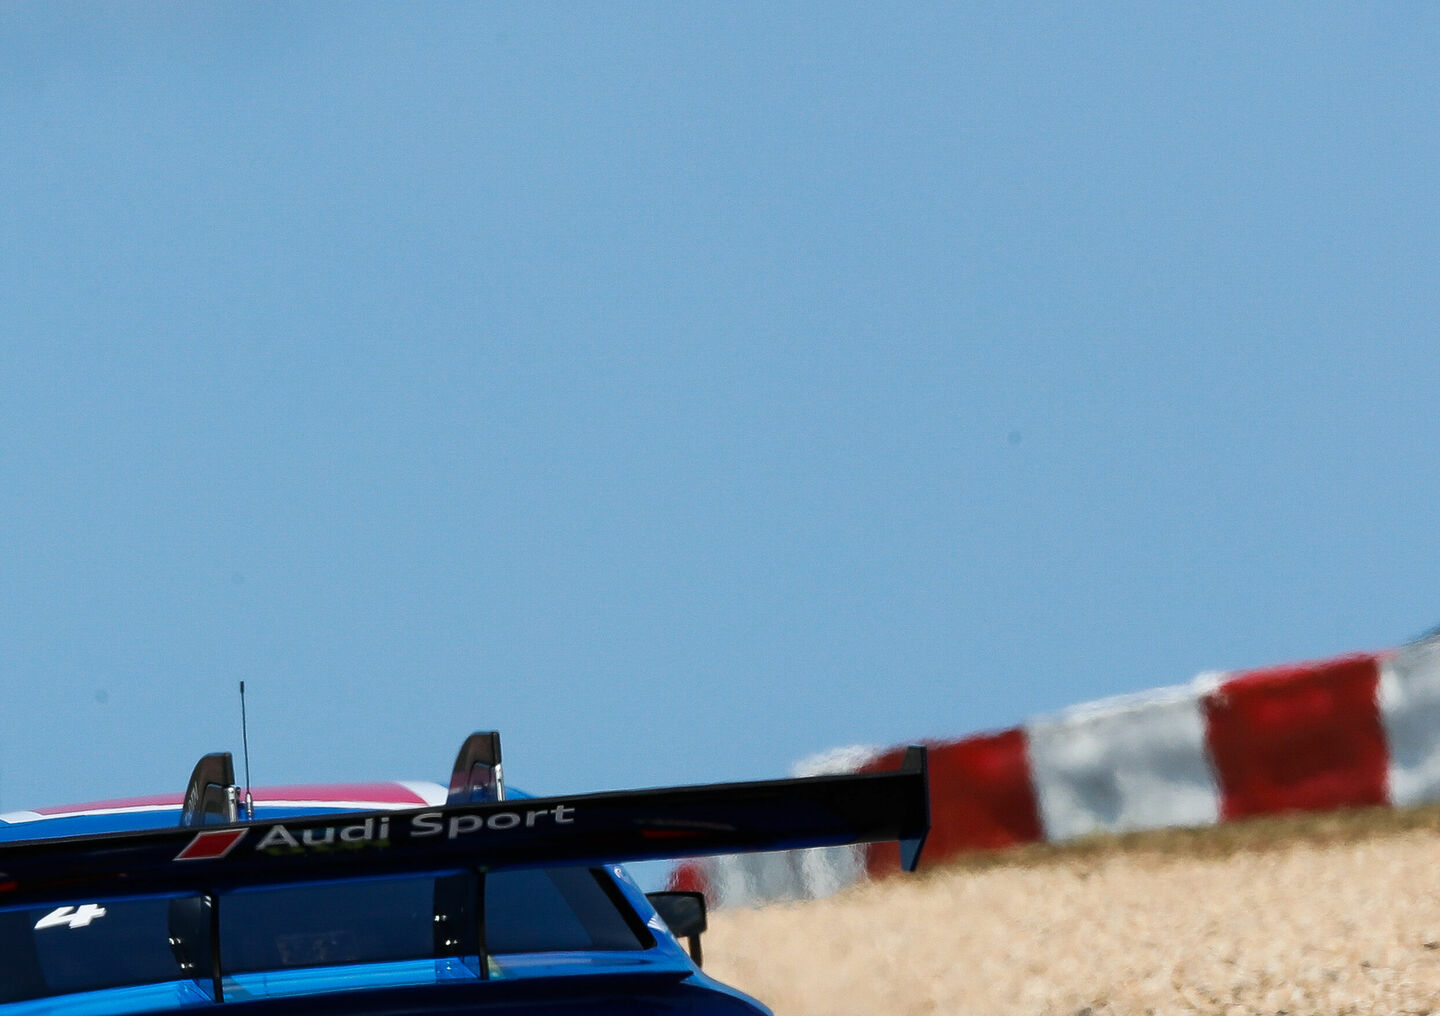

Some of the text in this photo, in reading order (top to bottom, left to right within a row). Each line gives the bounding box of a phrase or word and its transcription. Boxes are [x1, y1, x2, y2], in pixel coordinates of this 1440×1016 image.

[256, 804, 576, 850] Audi Sport
[34, 903, 107, 929] 4
